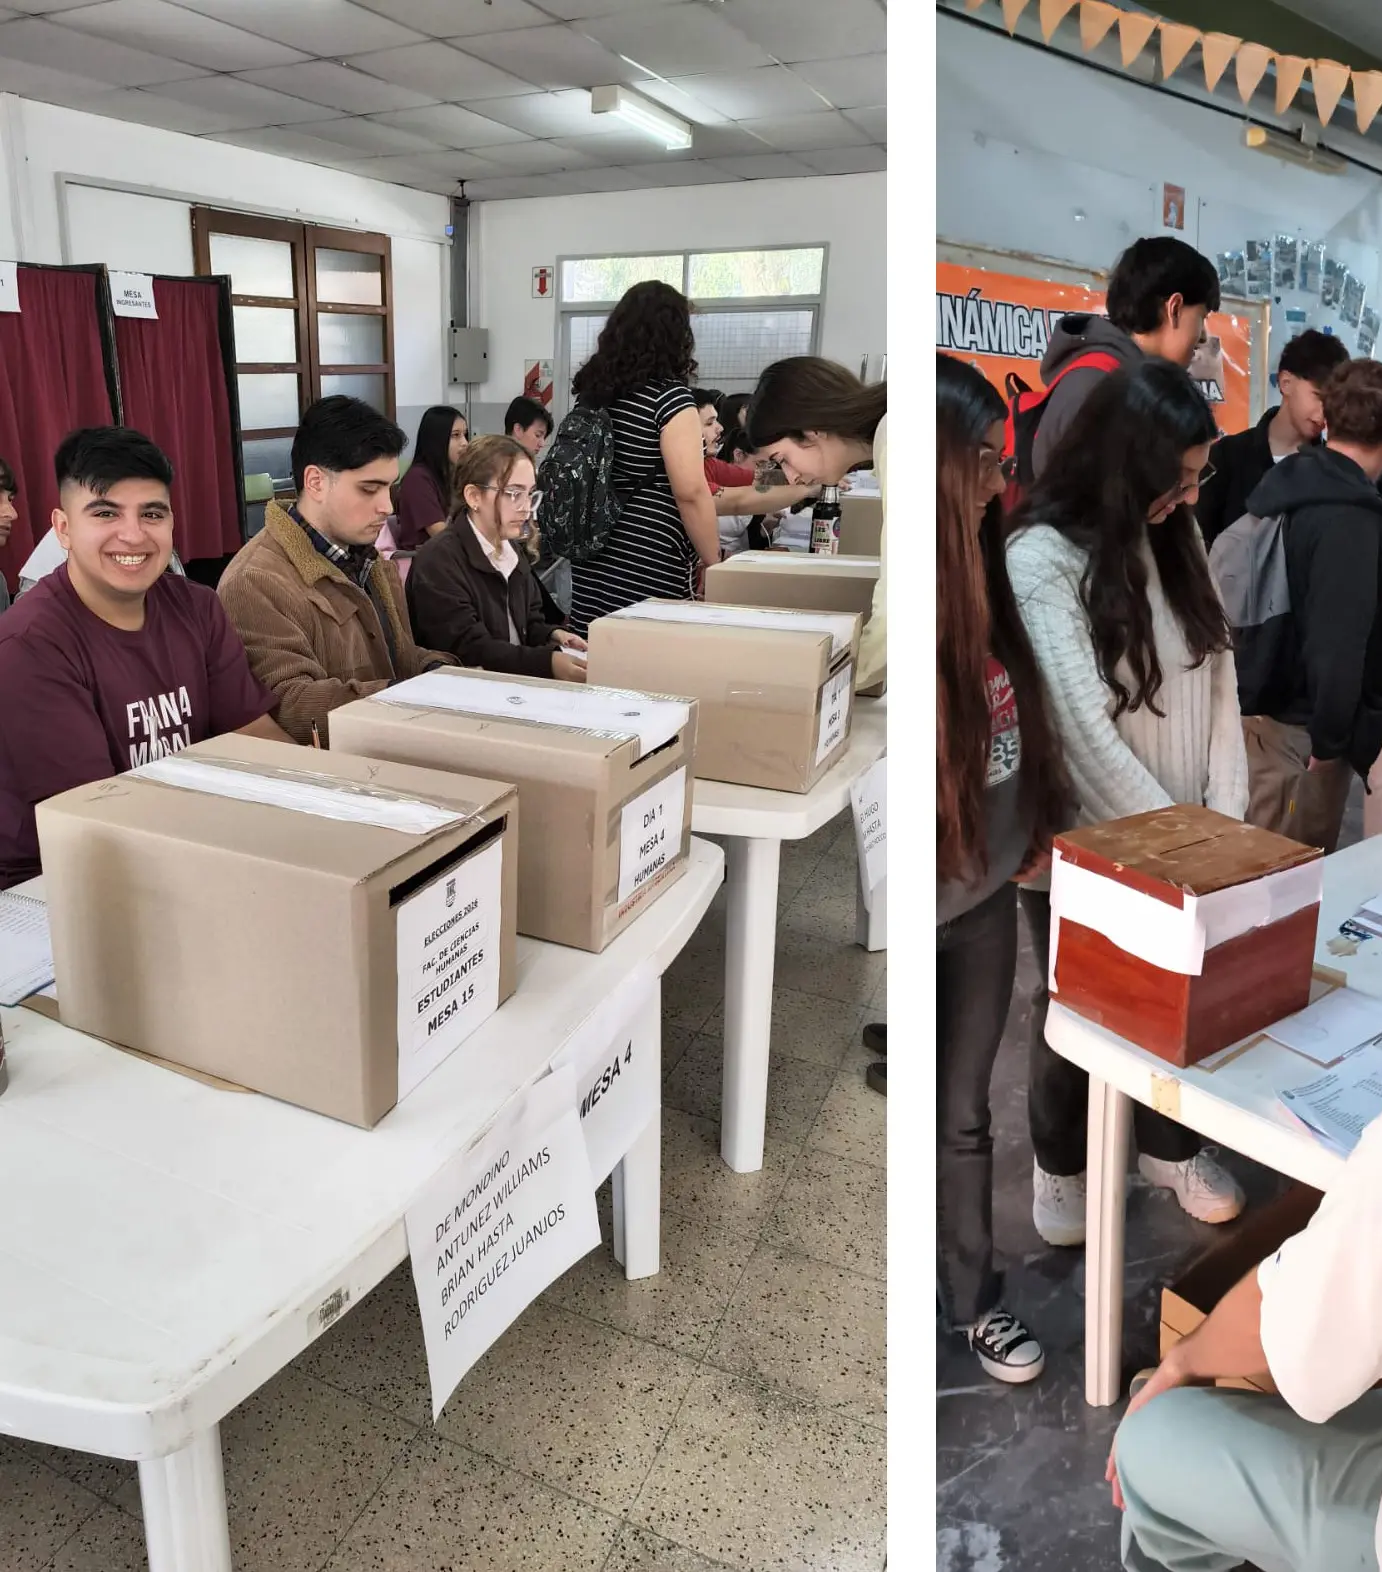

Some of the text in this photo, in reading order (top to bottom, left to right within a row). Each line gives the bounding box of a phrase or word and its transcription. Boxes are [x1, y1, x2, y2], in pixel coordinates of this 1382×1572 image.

[123, 289, 142, 299] MESA
[633, 852, 666, 888] HUMANAS
[639, 828, 666, 860] MESA 4
[422, 921, 480, 975] FAC. DE CIENCIAS
[423, 909, 463, 949] ELECCIONES
[417, 948, 485, 1014] ESTUDIANTES
[435, 943, 468, 976] HUMANAS
[427, 983, 475, 1037] MESA 15
[579, 1039, 633, 1121] MESA 4
[435, 1149, 511, 1243] DE MONDINO
[435, 1145, 551, 1277] ANTUNEZ WILLIAMS
[440, 1213, 515, 1308] BRIAN HASTA
[443, 1251, 510, 1342] RODRIGUEZ
[509, 1202, 566, 1269] JUANJOS
